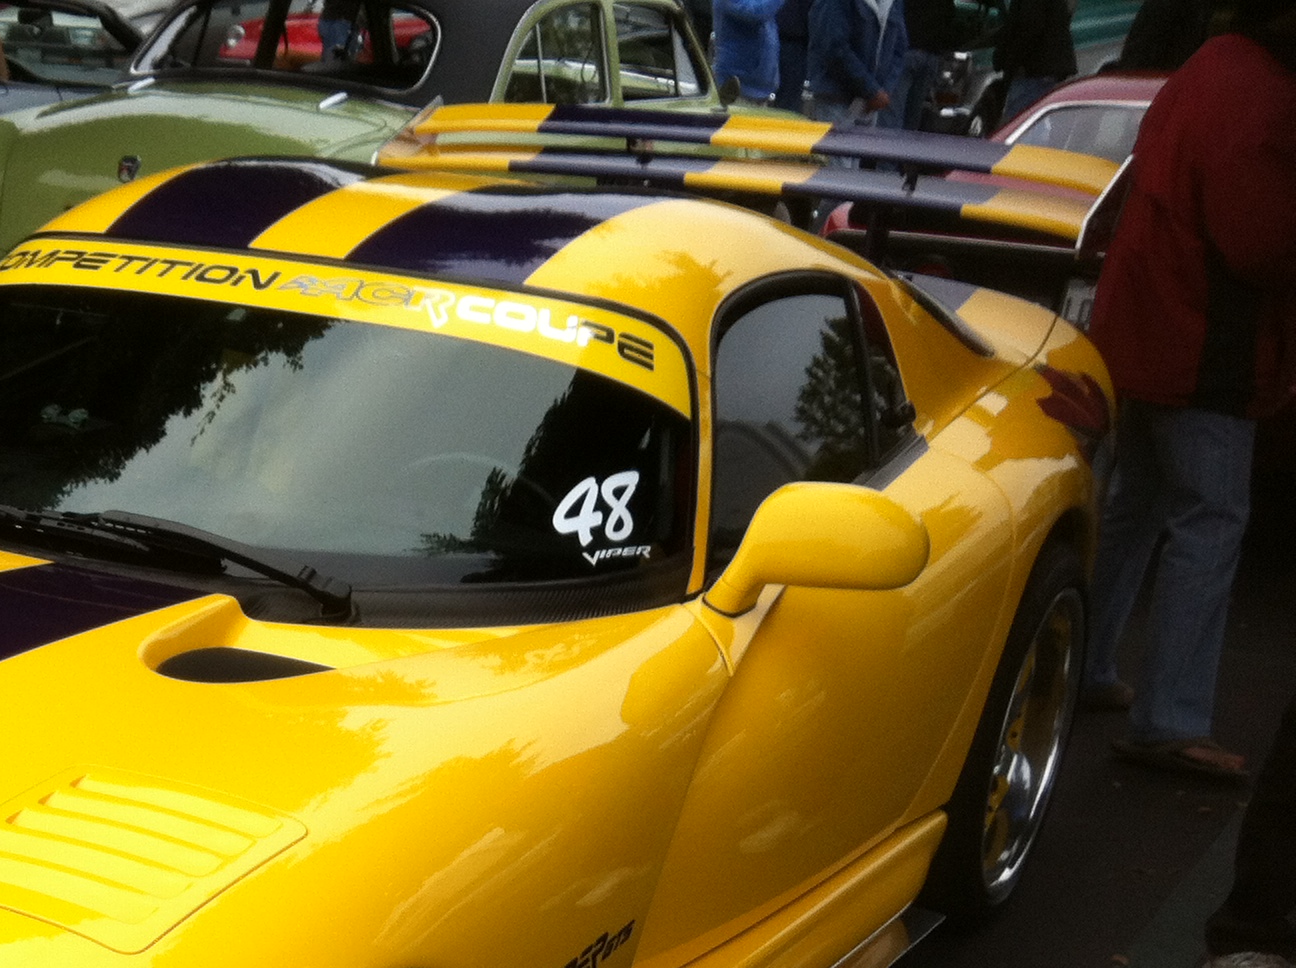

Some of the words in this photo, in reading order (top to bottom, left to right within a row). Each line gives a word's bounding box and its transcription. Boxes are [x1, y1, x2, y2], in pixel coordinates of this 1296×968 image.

[457, 295, 655, 371] COUPE
[553, 470, 640, 547] 48
[582, 545, 652, 567] VIPER
